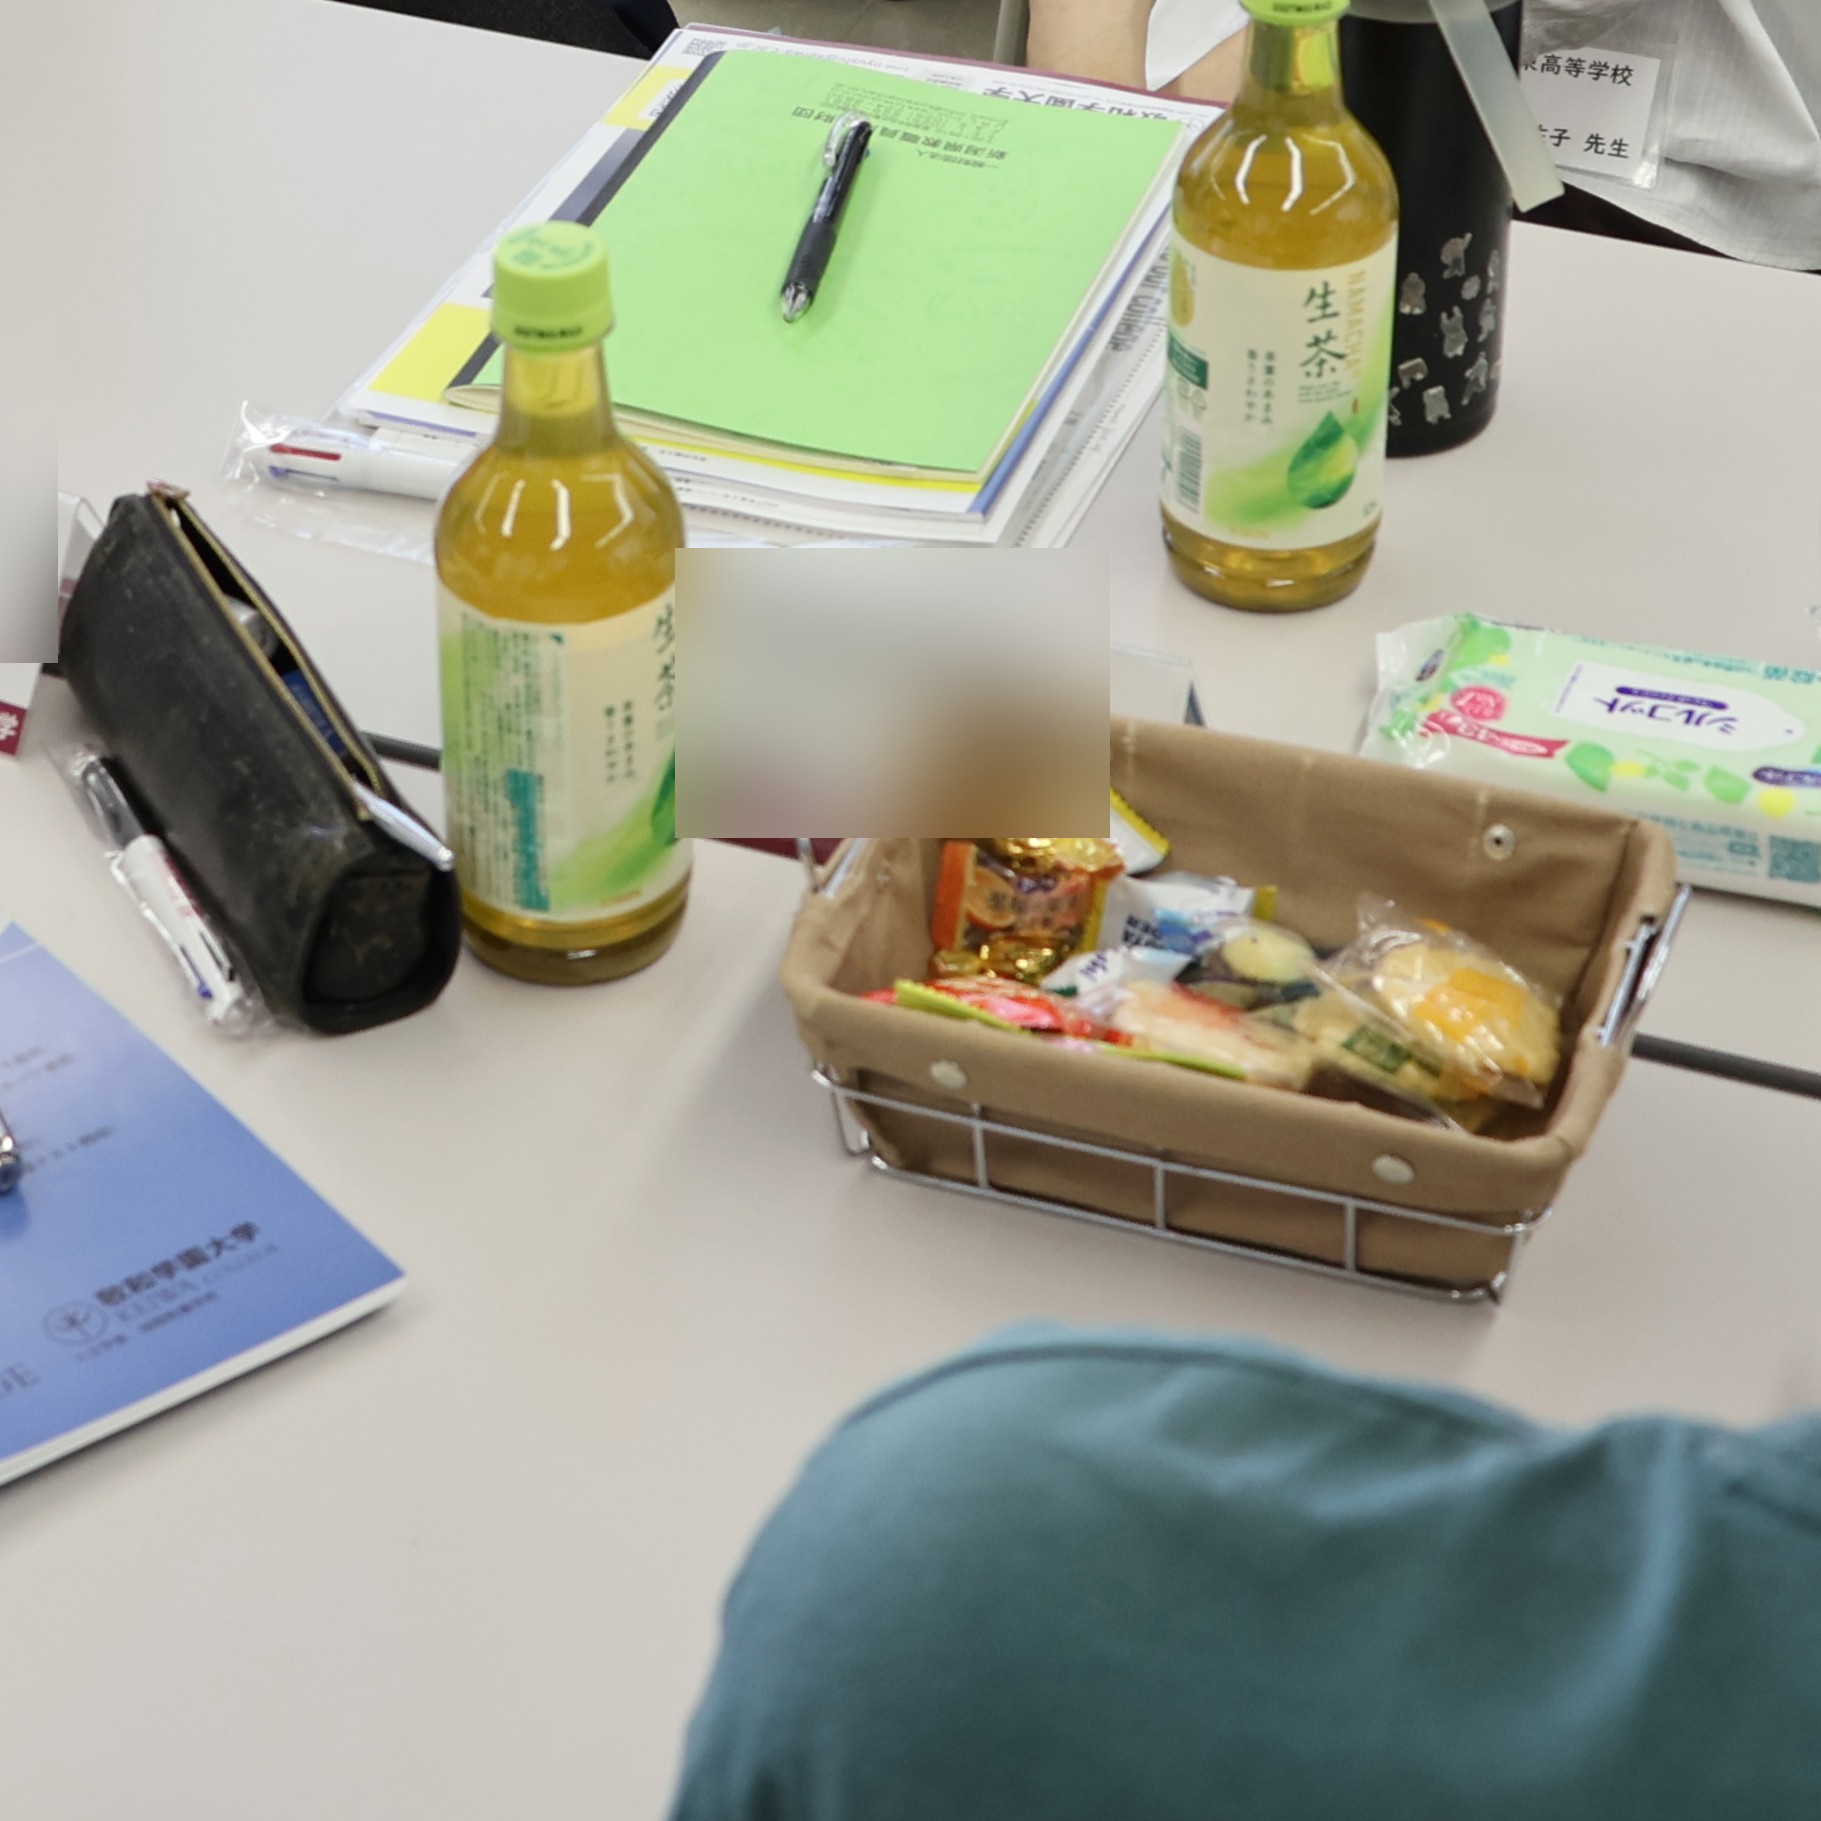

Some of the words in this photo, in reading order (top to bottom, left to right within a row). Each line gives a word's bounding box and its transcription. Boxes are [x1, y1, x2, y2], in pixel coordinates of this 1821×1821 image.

[791, 105, 1010, 162] 新潟県教職員財団
[1583, 132, 1630, 159] 先生
[1299, 280, 1348, 379] 生茶
[1345, 268, 1368, 377] NAMACHA
[1593, 694, 1740, 735] シルコット
[95, 1220, 260, 1307] 敬和学園大学
